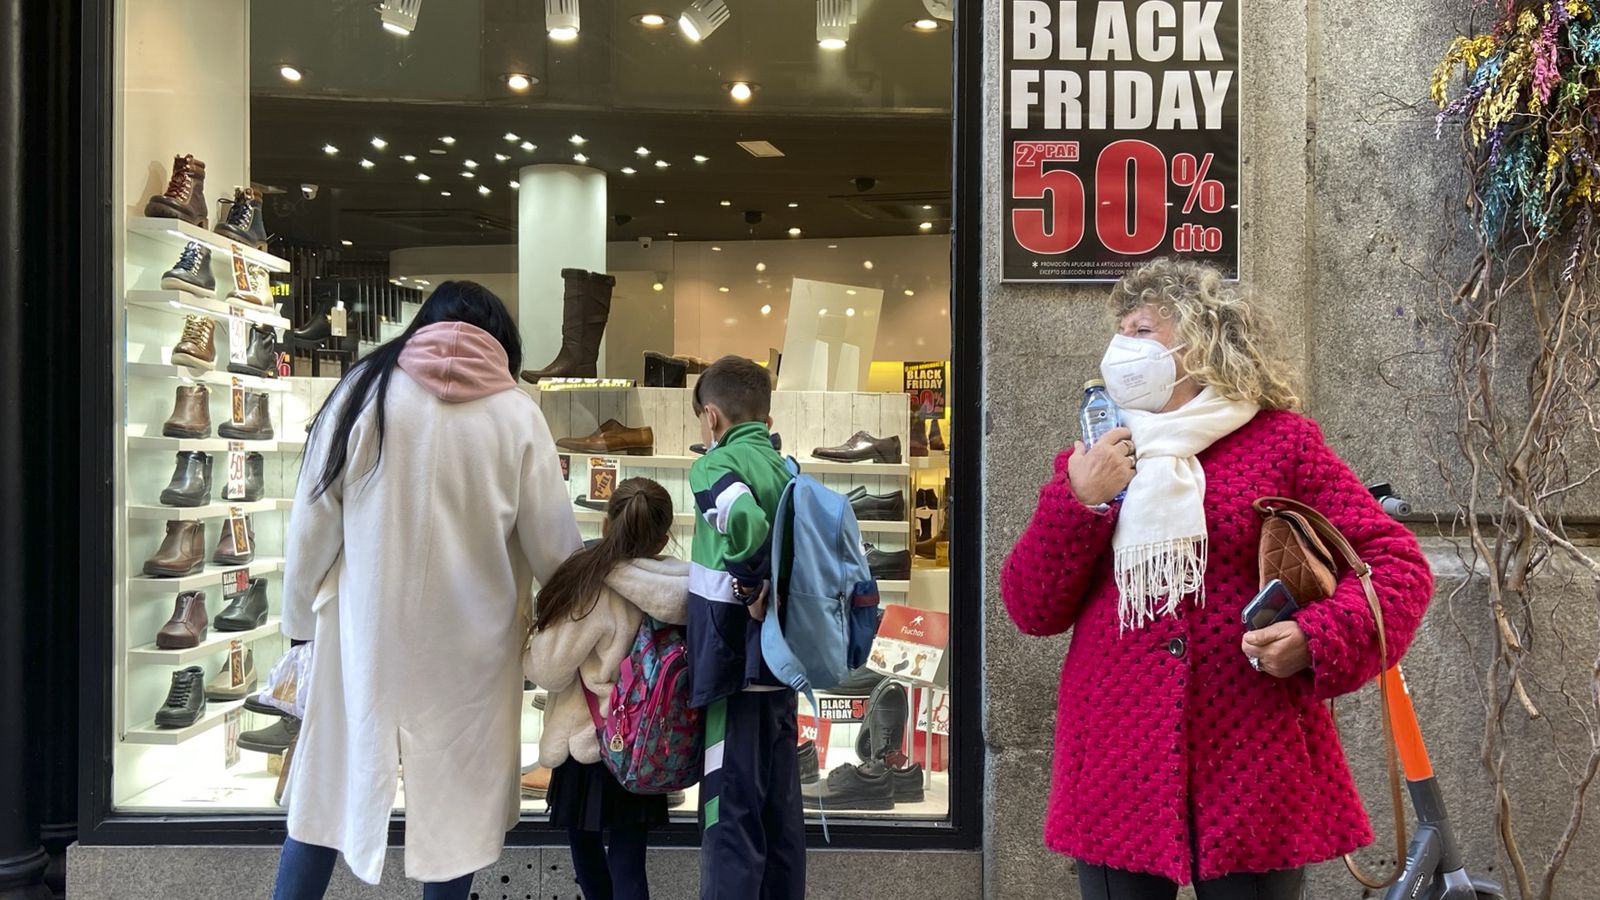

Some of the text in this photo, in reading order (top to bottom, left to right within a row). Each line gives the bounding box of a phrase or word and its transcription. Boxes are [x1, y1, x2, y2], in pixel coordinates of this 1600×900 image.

[1013, 0, 1224, 62] BLACK
[1010, 69, 1234, 130] FRIDAY
[1045, 145, 1078, 158] PAR
[1173, 223, 1222, 252] dto
[907, 369, 942, 380] BLACK
[906, 379, 943, 389] FRIDAY
[900, 625, 924, 638] Fluchos
[821, 699, 851, 709] BLACK
[821, 709, 853, 719] FRIDAY
